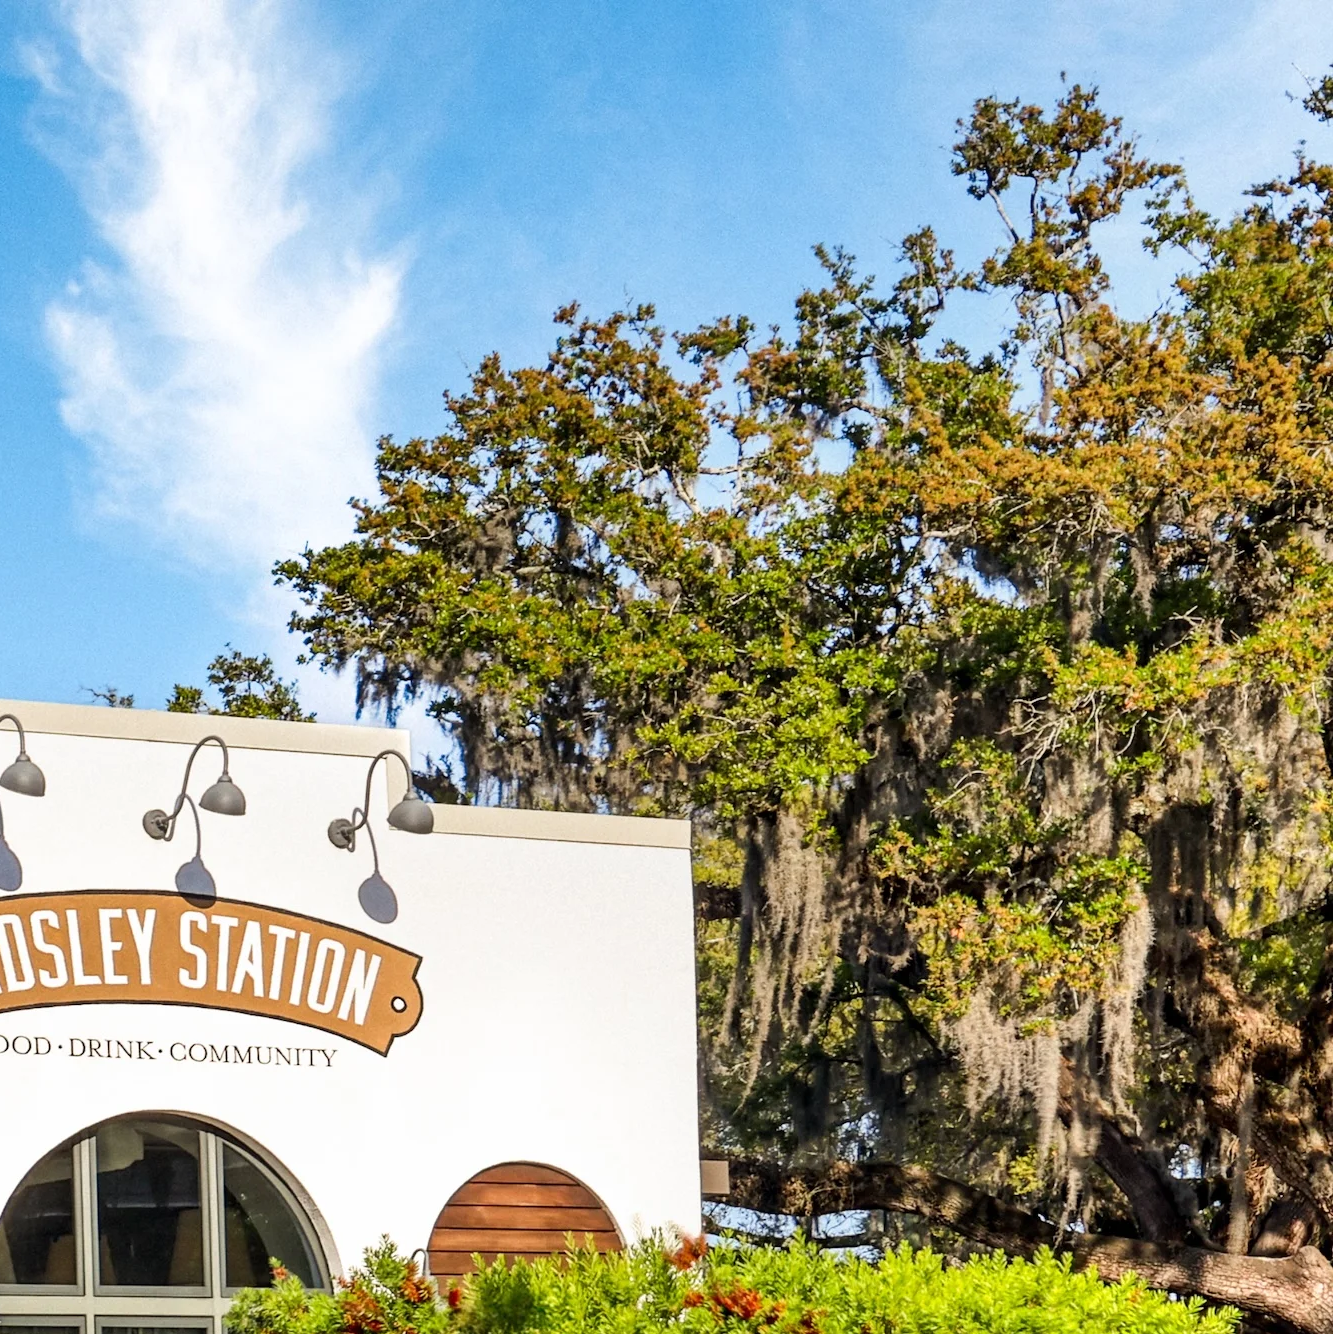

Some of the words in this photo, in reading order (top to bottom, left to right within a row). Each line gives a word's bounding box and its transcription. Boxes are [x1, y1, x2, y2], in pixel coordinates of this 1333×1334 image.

[178, 910, 383, 1026] STATION
[68, 1037, 156, 1060] DRINK
[169, 1042, 338, 1068] COMMUNITY
